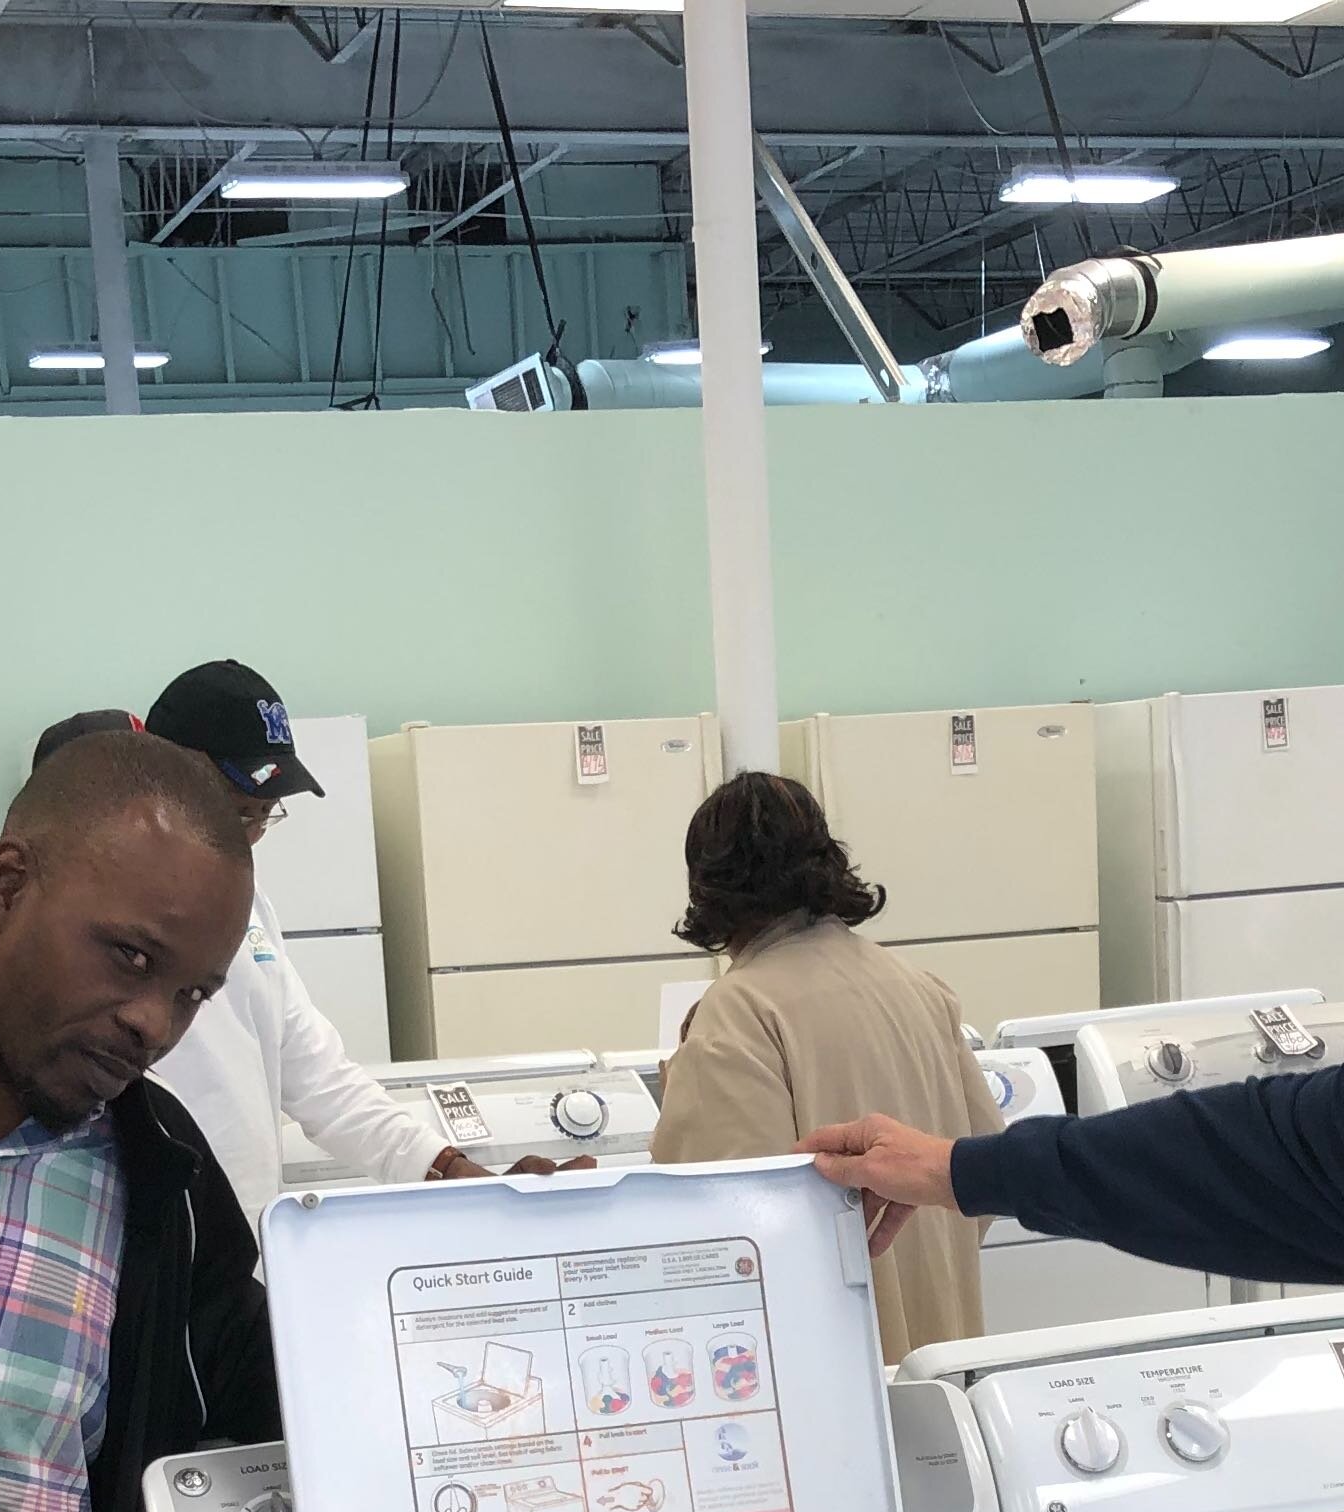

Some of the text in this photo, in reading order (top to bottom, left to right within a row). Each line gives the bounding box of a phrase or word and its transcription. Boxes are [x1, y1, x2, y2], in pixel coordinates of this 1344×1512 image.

[1265, 703, 1283, 715] SALE
[953, 720, 972, 731] SALE
[580, 731, 601, 741] SALE
[580, 743, 603, 754] PRICE
[1259, 1011, 1287, 1024] SALE
[1266, 1022, 1297, 1035] PRICE
[439, 1091, 469, 1105] SALE
[444, 1104, 477, 1119] PRICE
[580, 1265, 603, 1273] washer
[412, 1267, 533, 1292] Quick Start Guide
[568, 1303, 576, 1316] 2
[399, 1319, 407, 1331] 1
[669, 1326, 684, 1334] Load
[712, 1321, 729, 1329] Large
[602, 1332, 618, 1340] Load
[1140, 1364, 1204, 1379] TEMPERATURE
[1048, 1376, 1096, 1389] LOAD SIZE
[583, 1435, 592, 1447] 4
[415, 1453, 424, 1466] 3
[240, 1464, 270, 1474] LOAD
